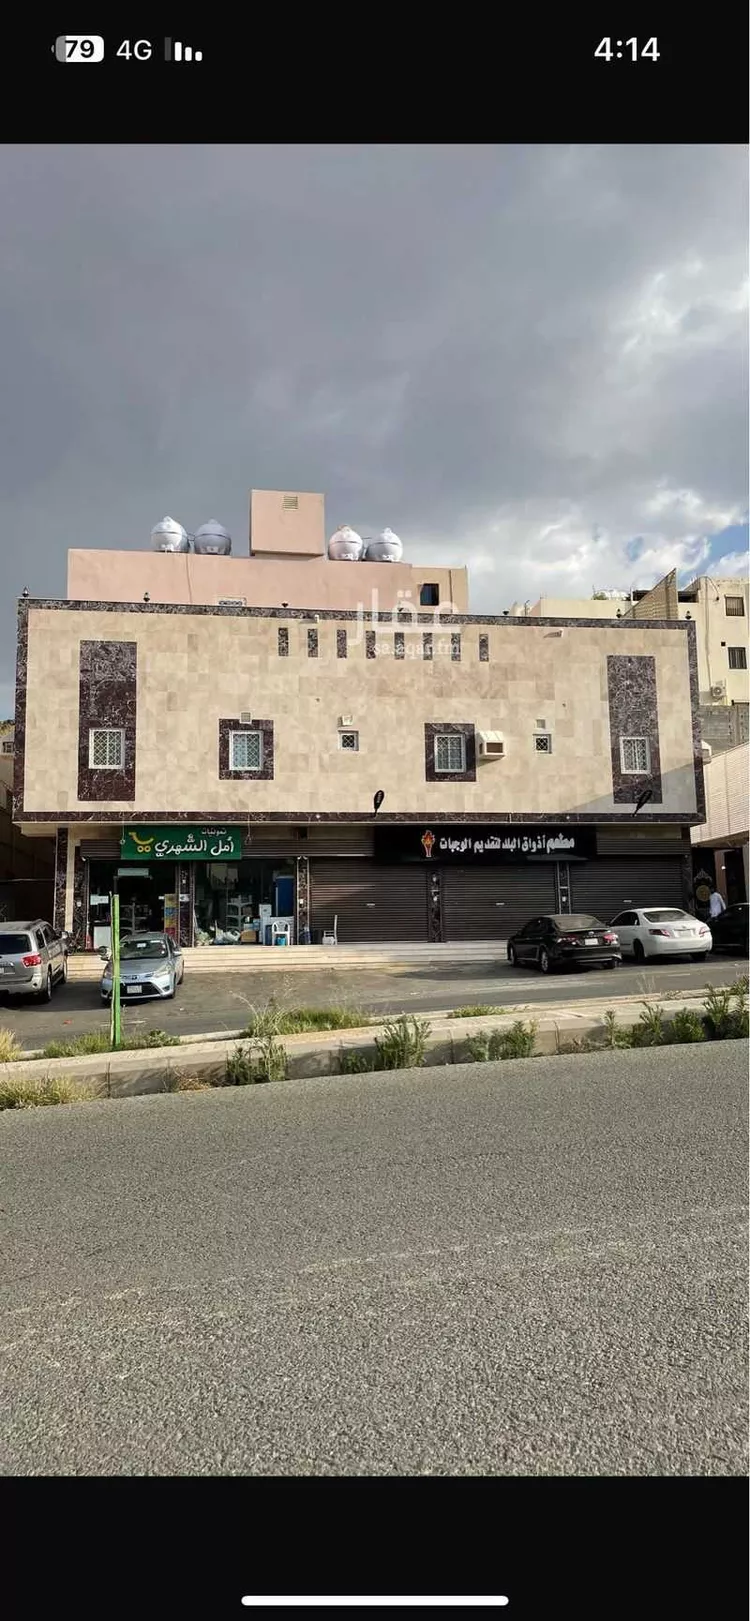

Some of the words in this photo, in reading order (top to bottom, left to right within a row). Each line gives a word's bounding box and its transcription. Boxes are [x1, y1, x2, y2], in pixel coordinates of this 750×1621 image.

[210, 836, 235, 856] أمل
[439, 836, 472, 853] الوجبات
[473, 835, 501, 853] لتقديم
[501, 837, 521, 853] البلد
[521, 834, 546, 853] أذواق
[546, 832, 575, 854] مطعم
